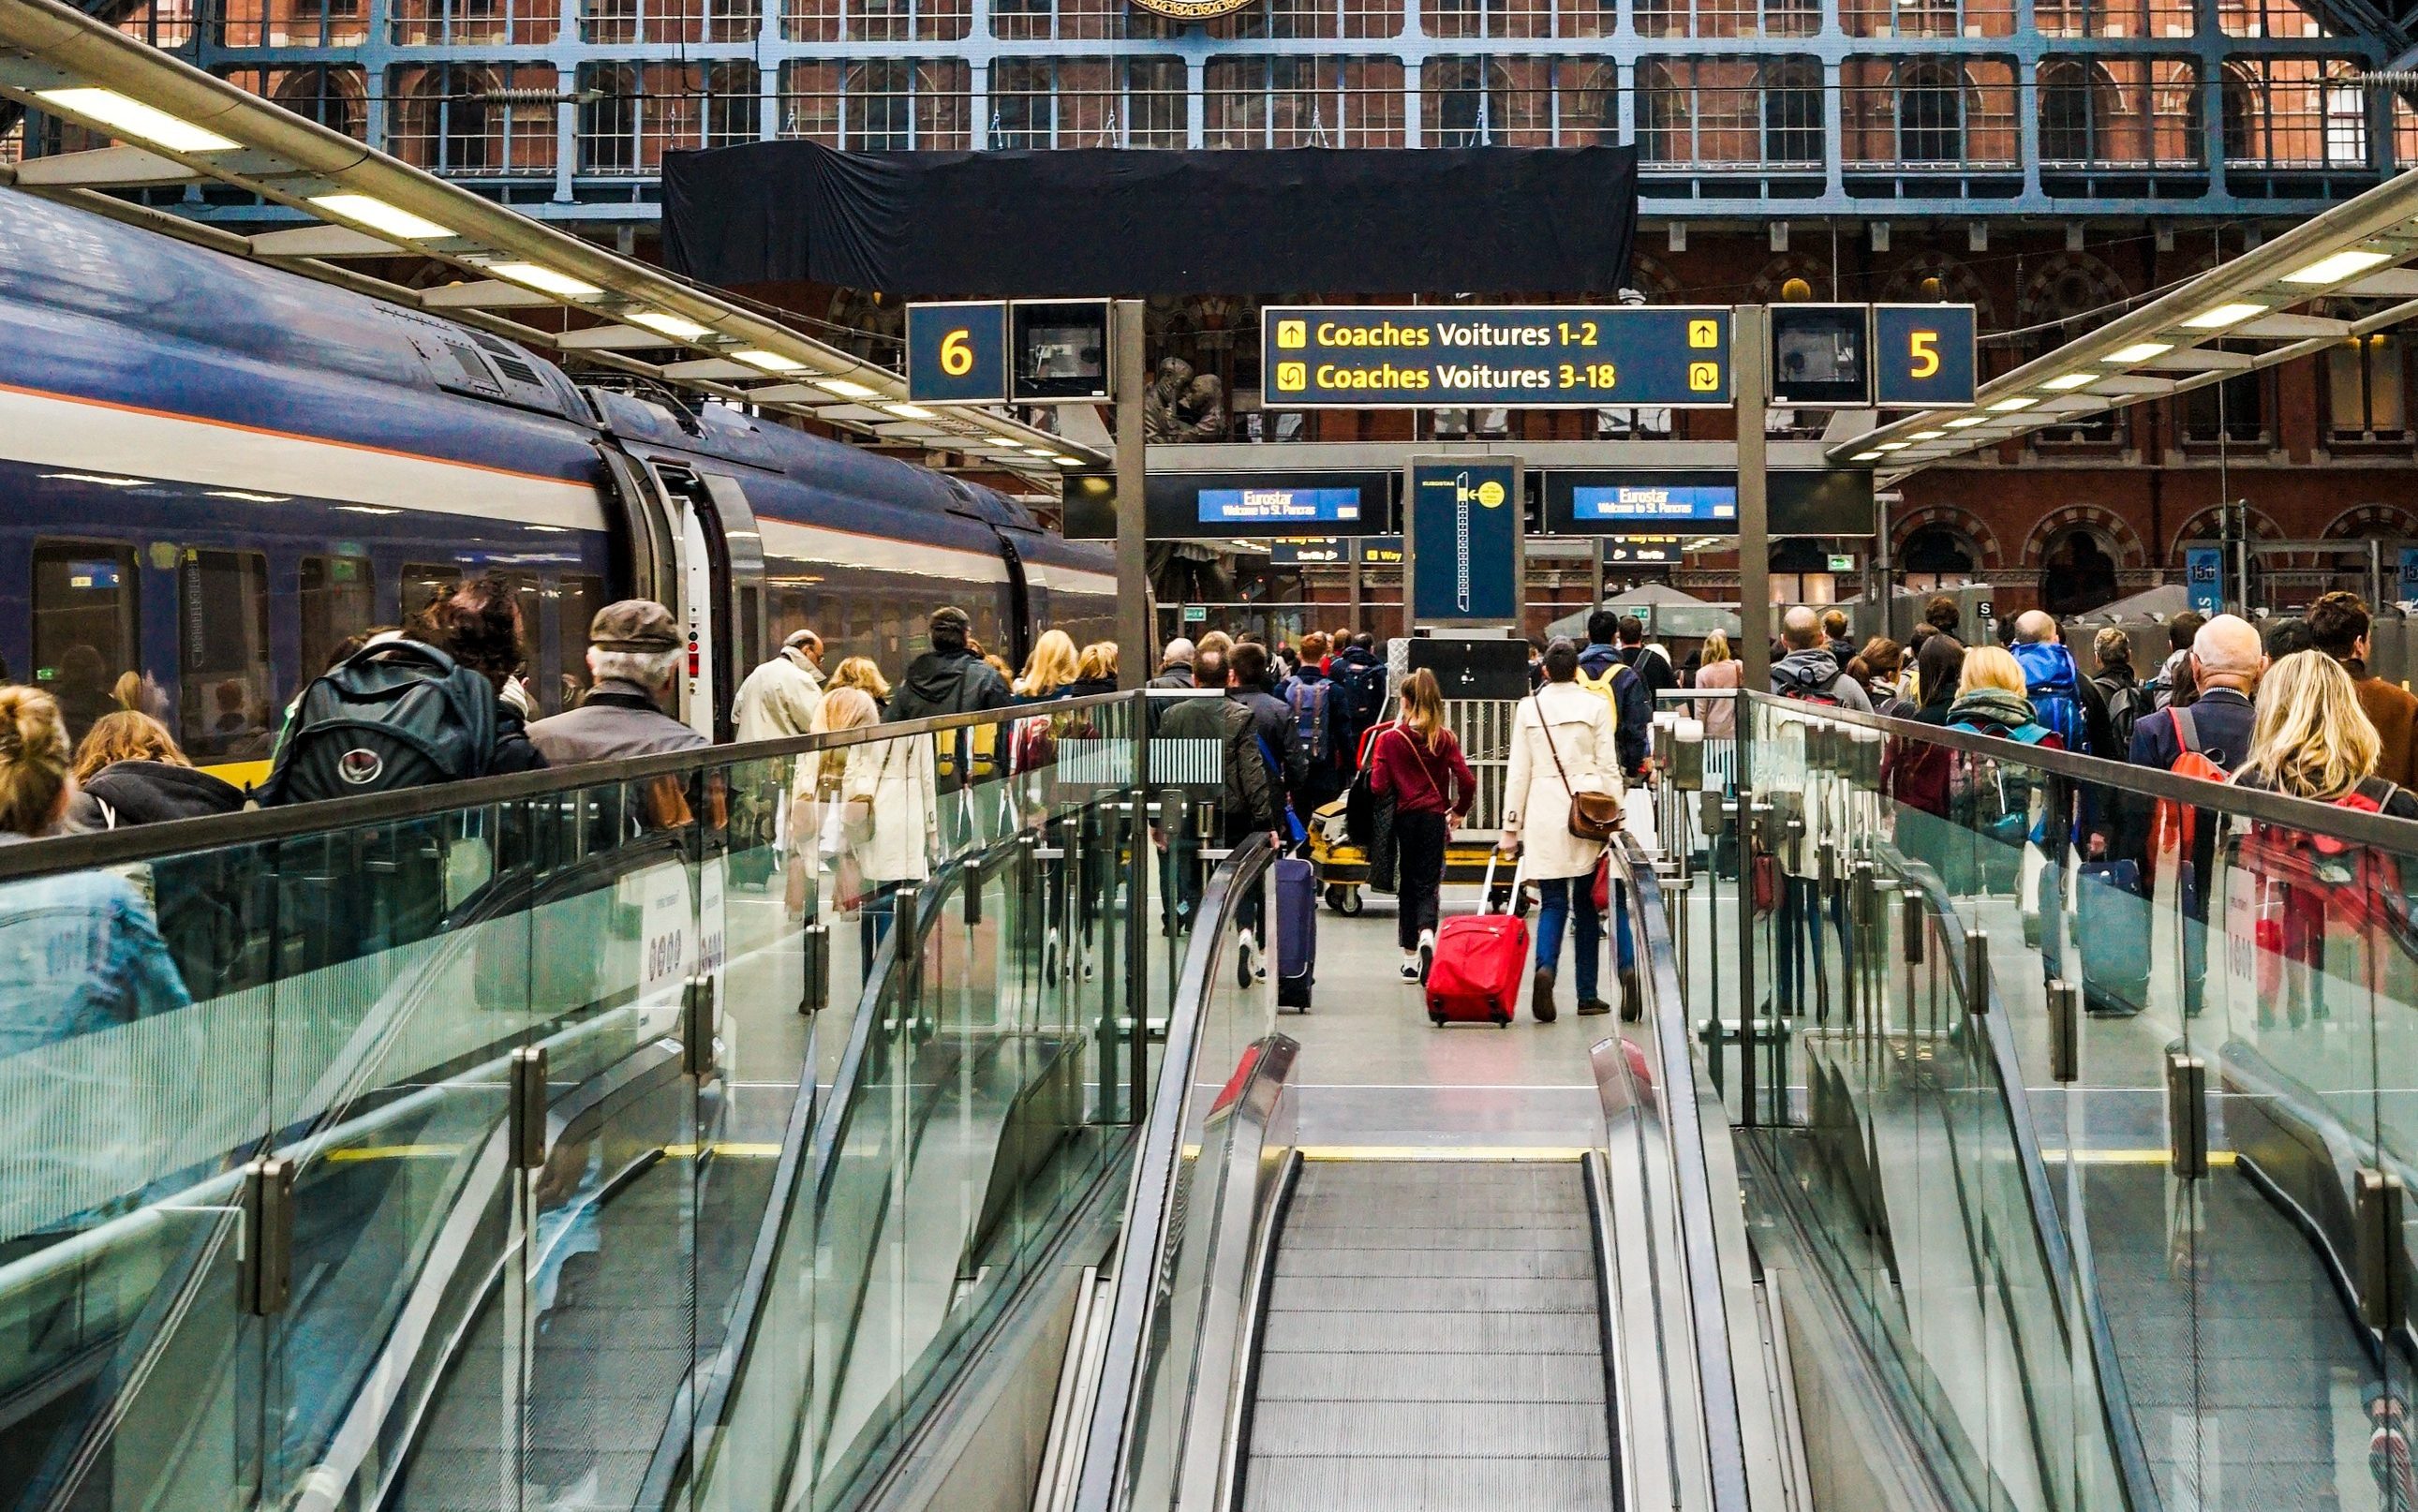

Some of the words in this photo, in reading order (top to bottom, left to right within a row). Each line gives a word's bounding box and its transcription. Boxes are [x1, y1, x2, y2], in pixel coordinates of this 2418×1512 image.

[1317, 321, 1430, 347] Coaches
[1436, 322, 1551, 347] Voitures
[1558, 322, 1598, 346] 1-2
[941, 330, 972, 376] 6
[1910, 332, 1940, 378] 5
[1316, 363, 1430, 389] Coaches
[1436, 364, 1551, 389] Voitures
[1559, 364, 1616, 389] 3-18
[1243, 491, 1294, 505] Eurostar
[1619, 488, 1669, 503] Eurostar
[1222, 505, 1259, 515] Welcome
[1259, 505, 1269, 515] to
[1283, 505, 1316, 515] Pancras
[1597, 503, 1635, 513] Welcome
[1635, 503, 1646, 513] to
[1658, 503, 1693, 513] Pancras
[1380, 551, 1402, 562] Way
[2404, 565, 2418, 579] 15
[1980, 602, 1991, 615] S
